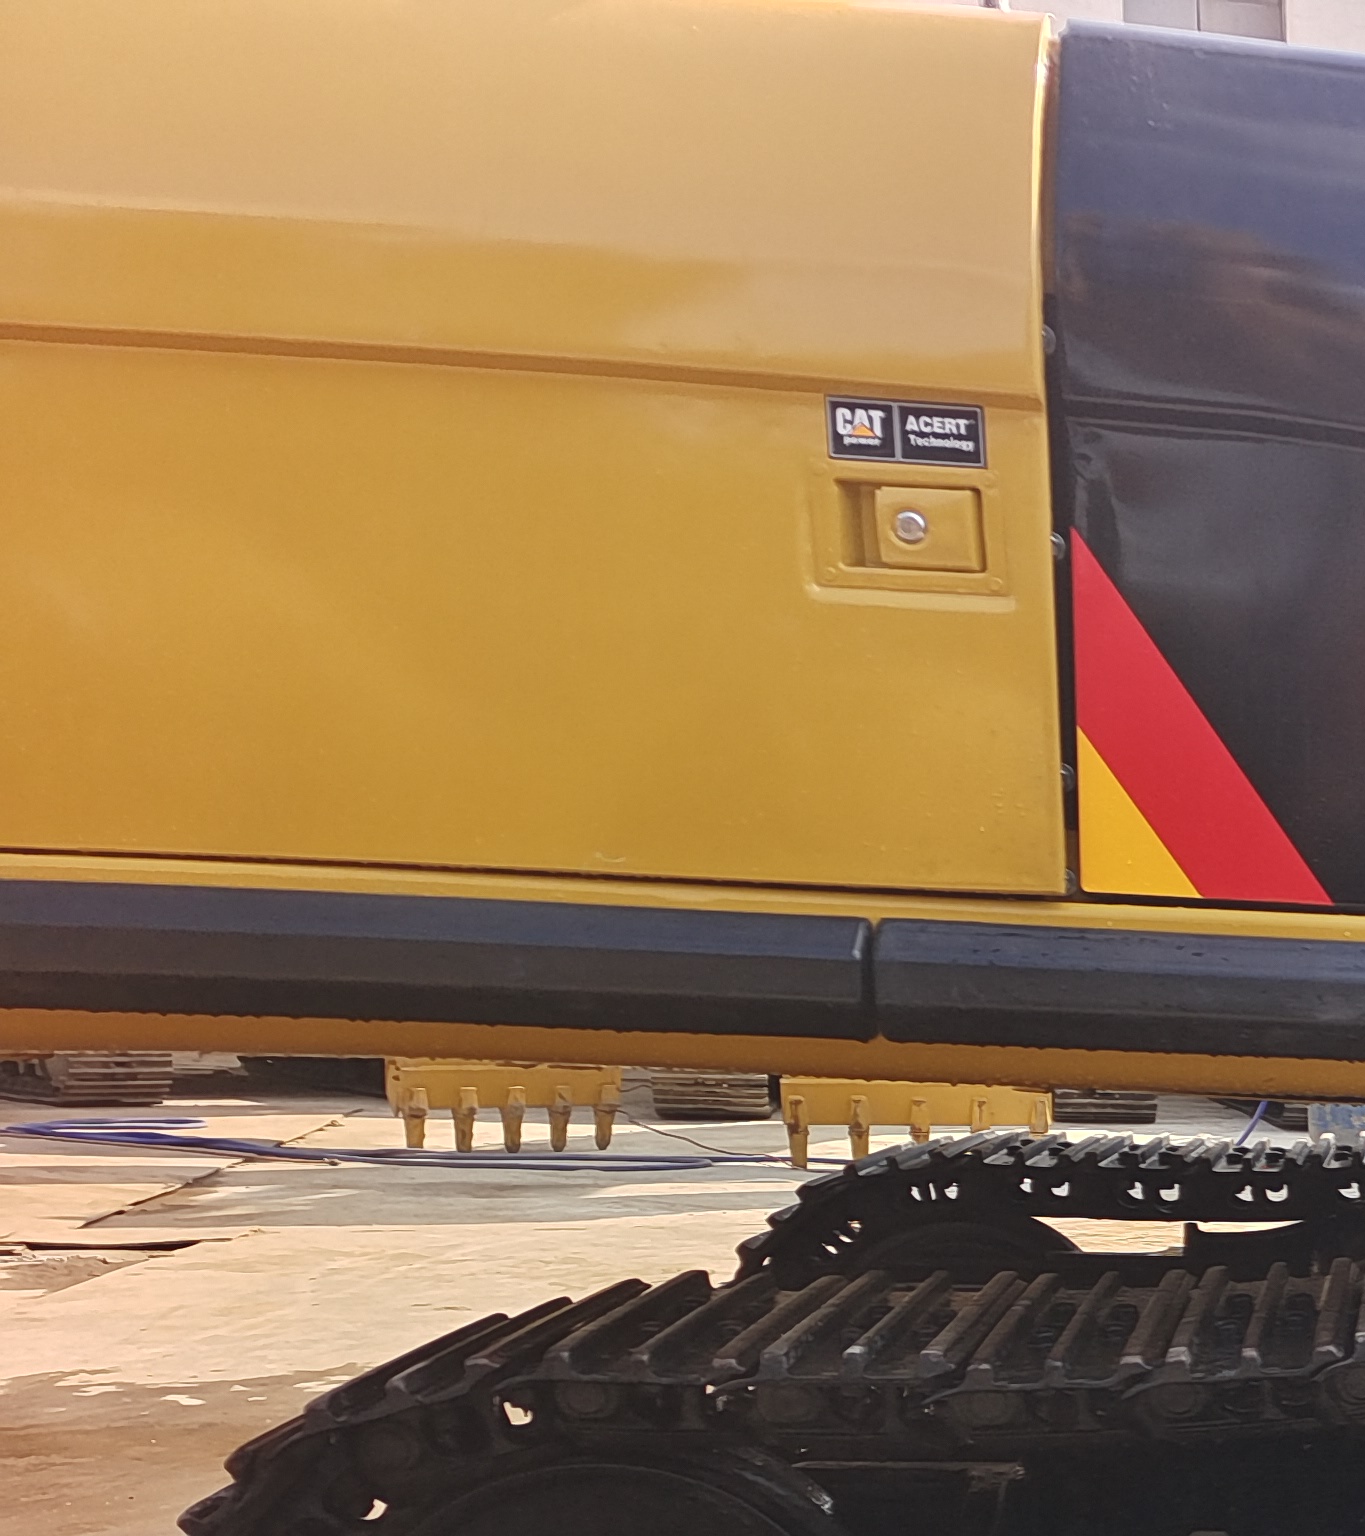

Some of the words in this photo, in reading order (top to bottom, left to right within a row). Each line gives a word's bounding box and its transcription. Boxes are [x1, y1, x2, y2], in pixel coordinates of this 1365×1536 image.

[836, 407, 884, 438] CAT
[843, 436, 882, 446] power
[908, 434, 975, 452] Technology
